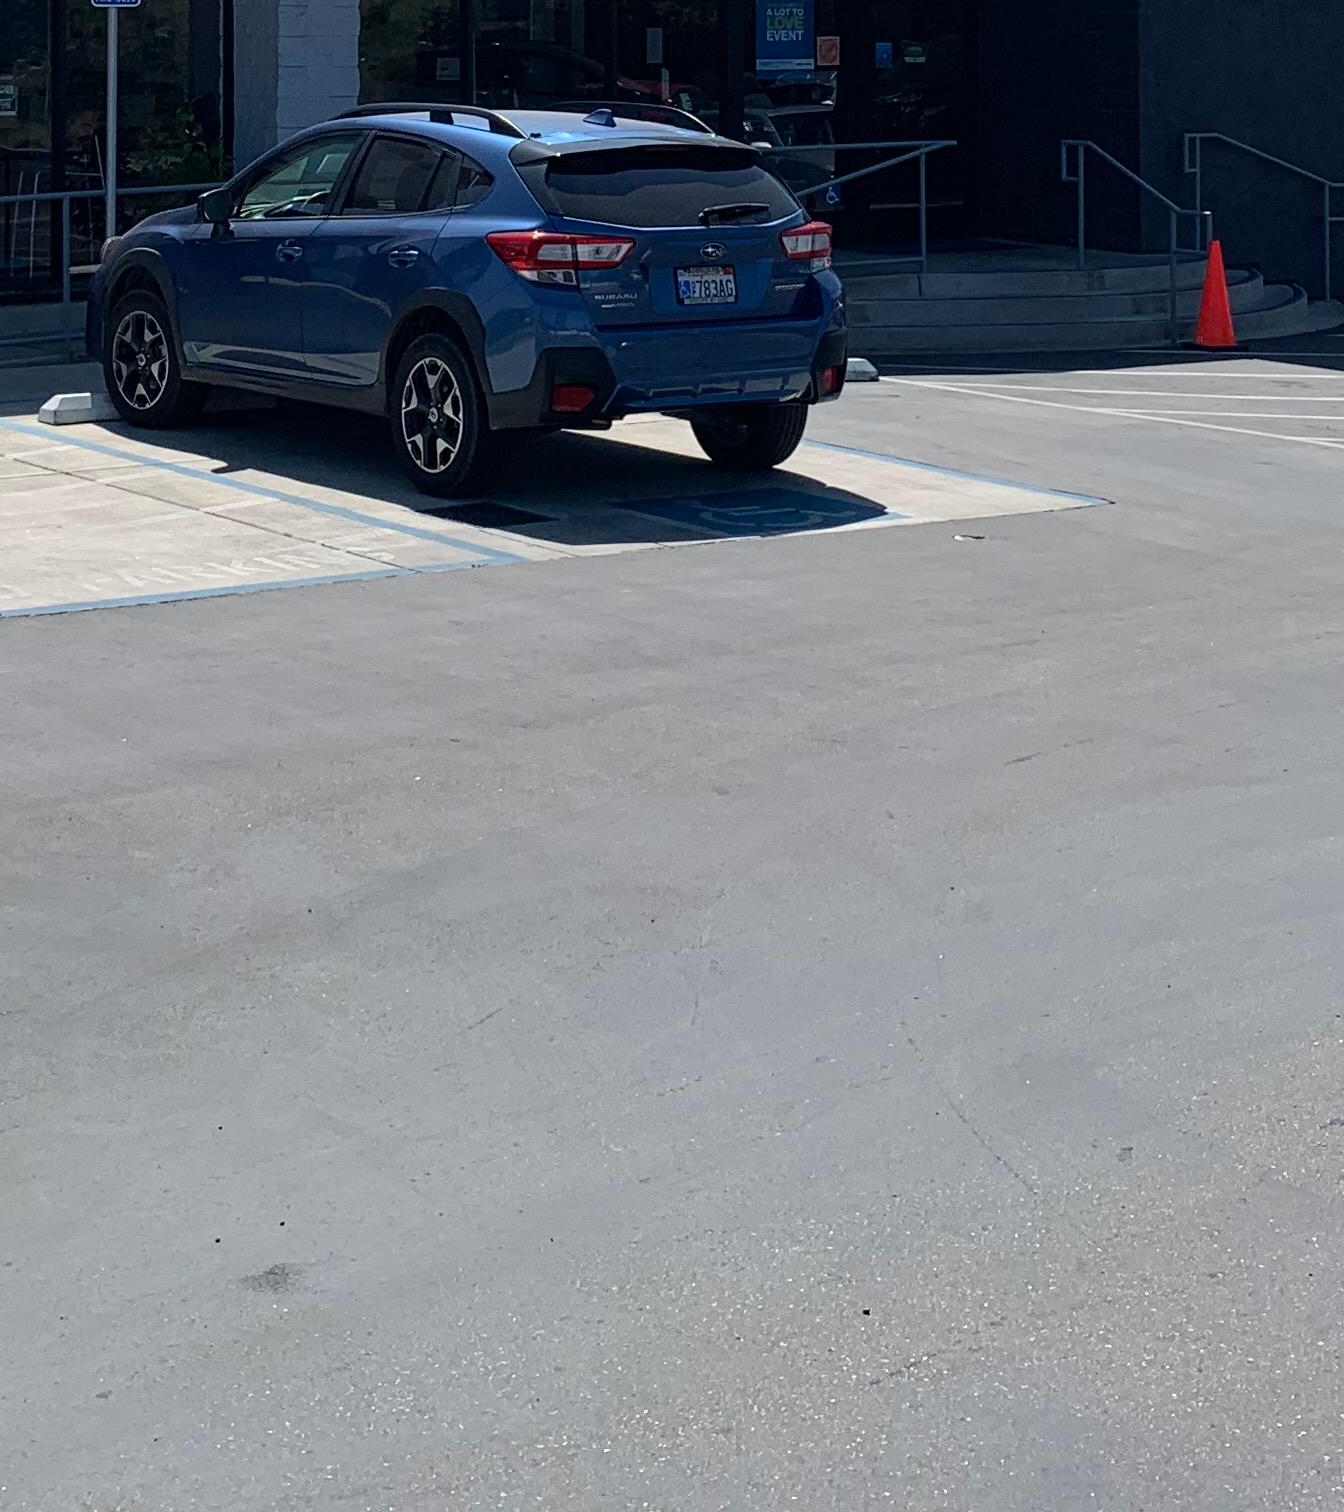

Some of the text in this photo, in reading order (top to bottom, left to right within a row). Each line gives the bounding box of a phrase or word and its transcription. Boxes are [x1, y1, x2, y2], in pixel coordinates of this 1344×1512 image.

[766, 8, 804, 16] A LOT TO
[766, 16, 804, 30] LOVE
[766, 30, 804, 42] EVENT
